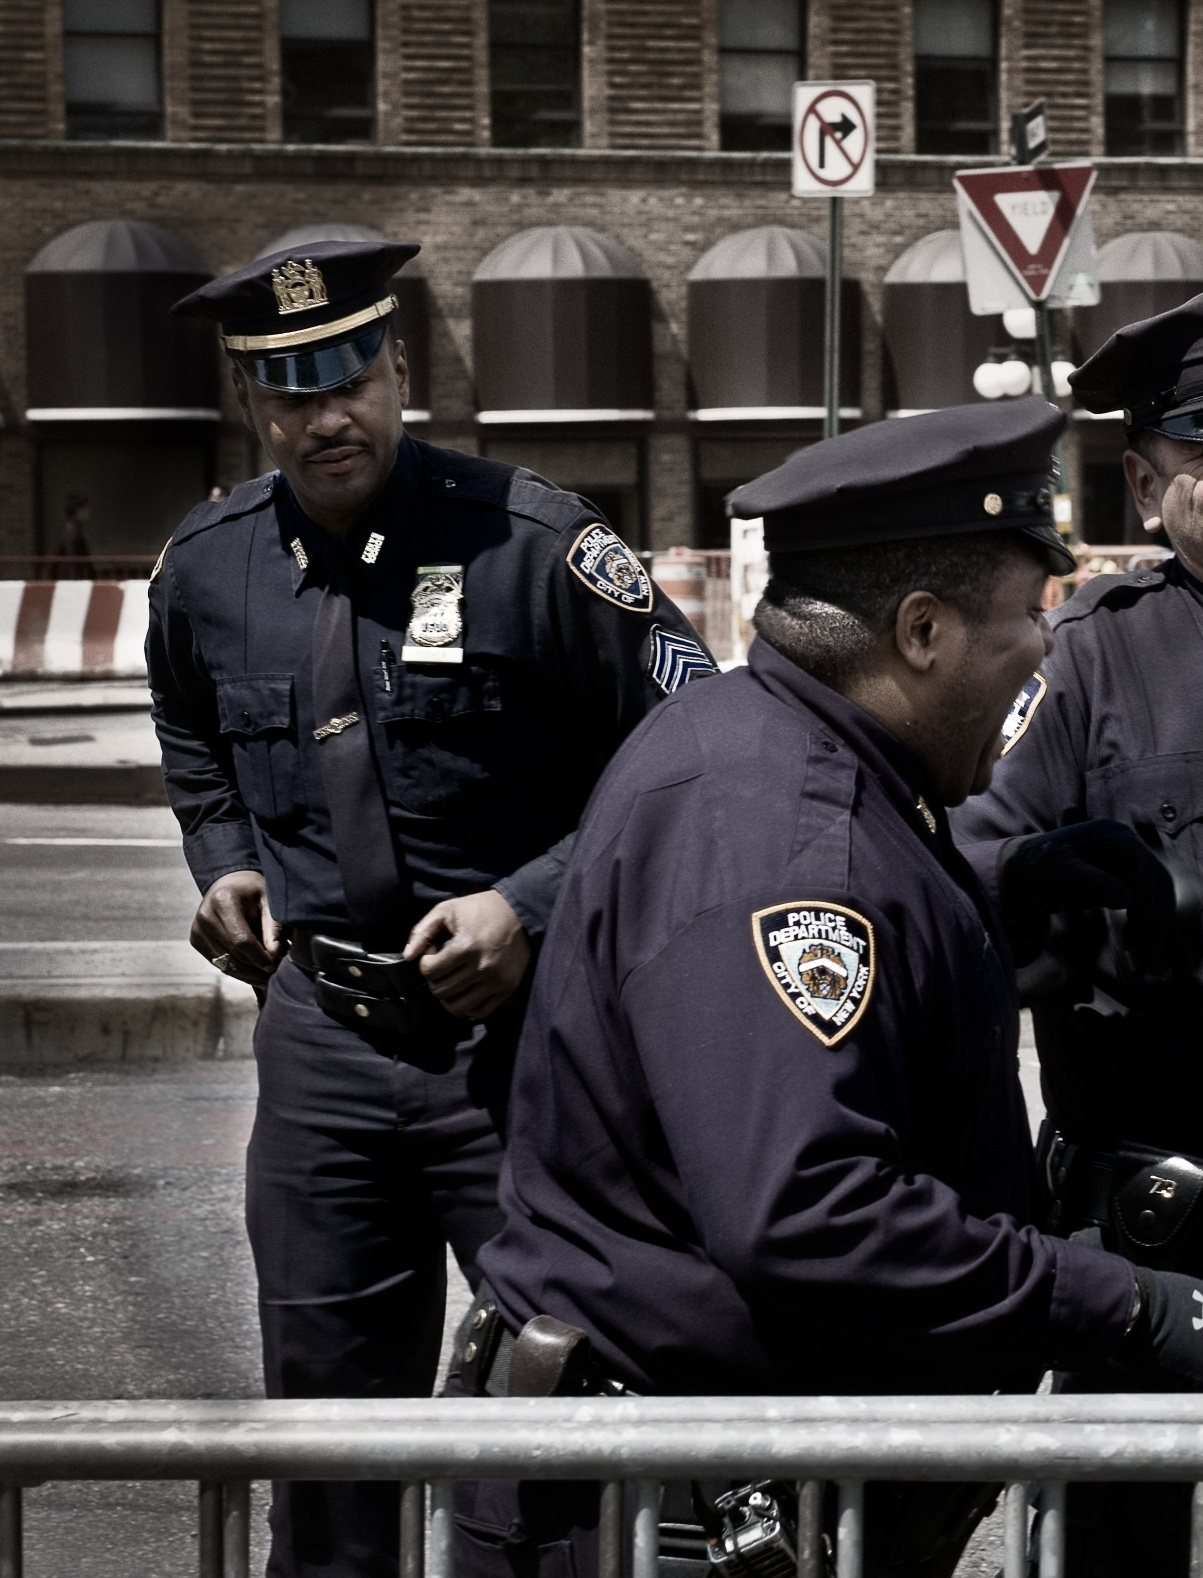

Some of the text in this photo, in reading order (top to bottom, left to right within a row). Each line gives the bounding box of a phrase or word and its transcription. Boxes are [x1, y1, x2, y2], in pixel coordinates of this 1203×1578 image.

[1010, 200, 1048, 216] YIELD
[580, 529, 605, 553] POLICE
[596, 581, 635, 603] CITY OF
[787, 911, 847, 931] POLICE
[768, 925, 867, 953] DEPARTMENT
[772, 961, 817, 1016] CITY OF
[831, 963, 869, 1025] NEW YORK
